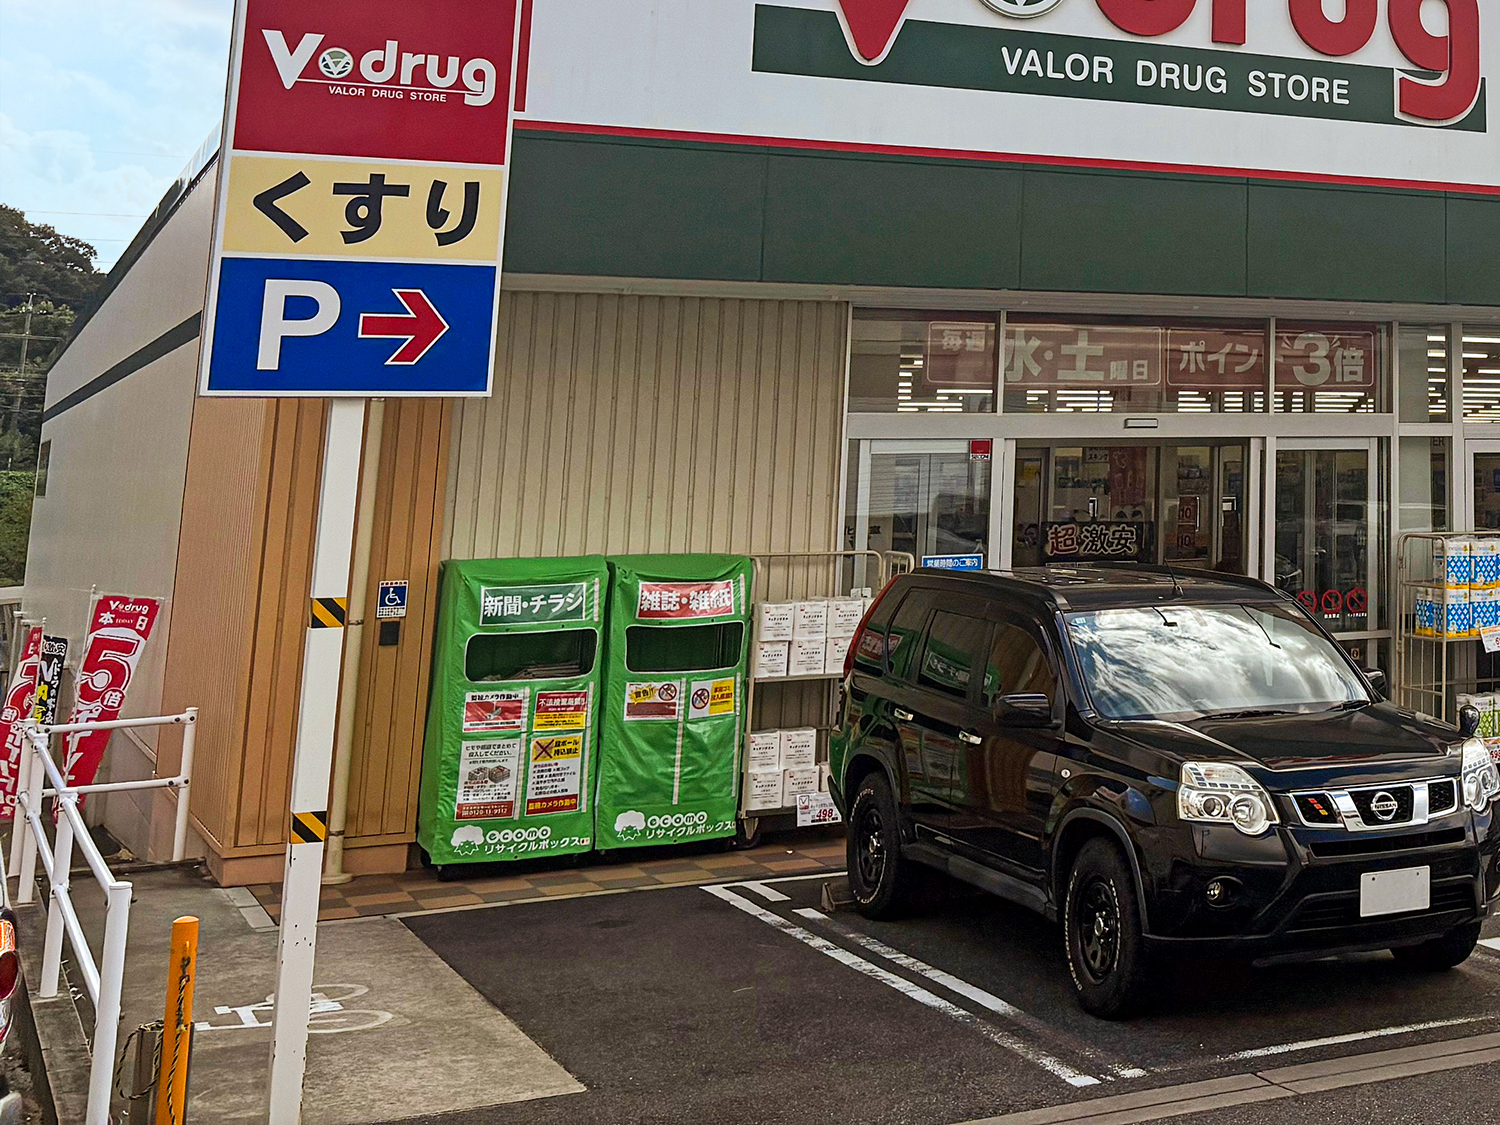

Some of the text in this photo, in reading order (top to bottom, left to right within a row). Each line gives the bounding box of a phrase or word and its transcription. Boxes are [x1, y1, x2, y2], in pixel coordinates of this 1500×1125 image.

[1001, 45, 1350, 106] VALOR DRUG STORE
[328, 86, 447, 103] VALOR DRUG STORE
[252, 170, 481, 247] くすり
[256, 278, 342, 371] P
[1047, 524, 1137, 556] 超激安
[484, 592, 583, 617] 新聞・チラシ
[640, 588, 732, 611] 雑誌・雑紙
[816, 808, 834, 819] 498
[486, 825, 552, 844] ecomo
[646, 820, 732, 840] リサイクルボックス
[484, 836, 581, 855] リサイクルボックス
